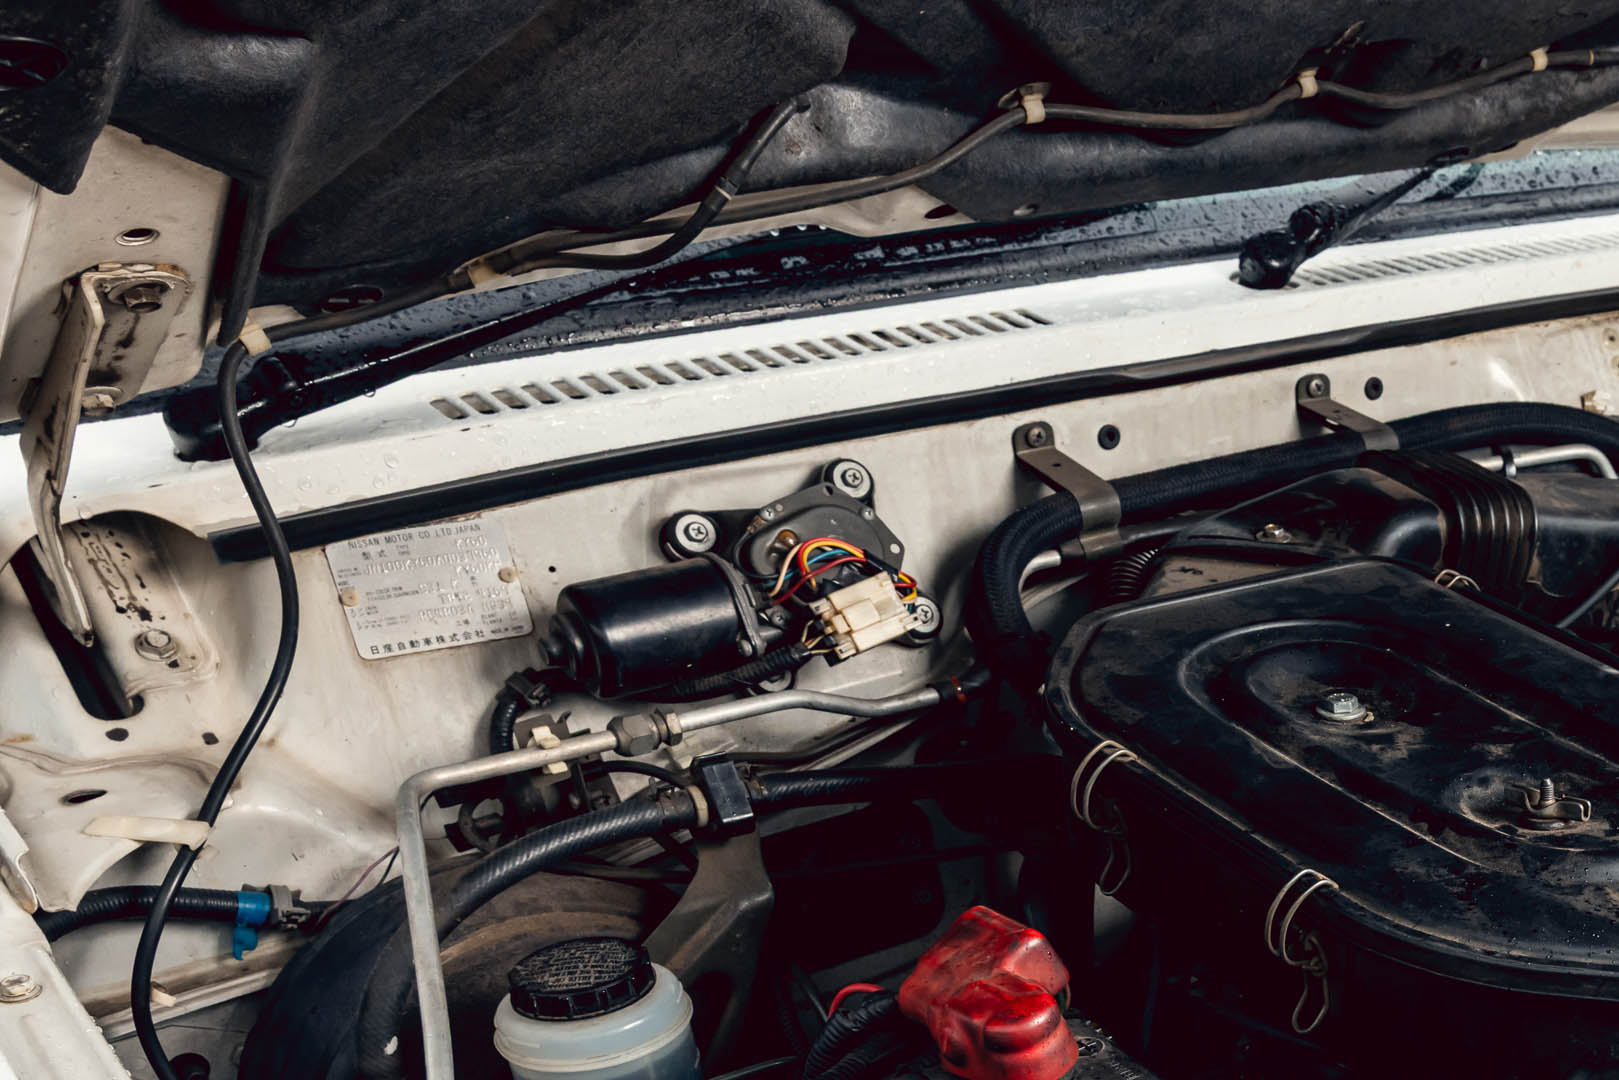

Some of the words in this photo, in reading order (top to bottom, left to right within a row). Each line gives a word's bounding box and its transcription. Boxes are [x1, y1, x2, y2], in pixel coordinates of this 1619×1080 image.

[348, 537, 380, 550] NISSAN
[384, 533, 413, 544] MOTOR
[370, 629, 486, 656] 日産自動車株式会社
